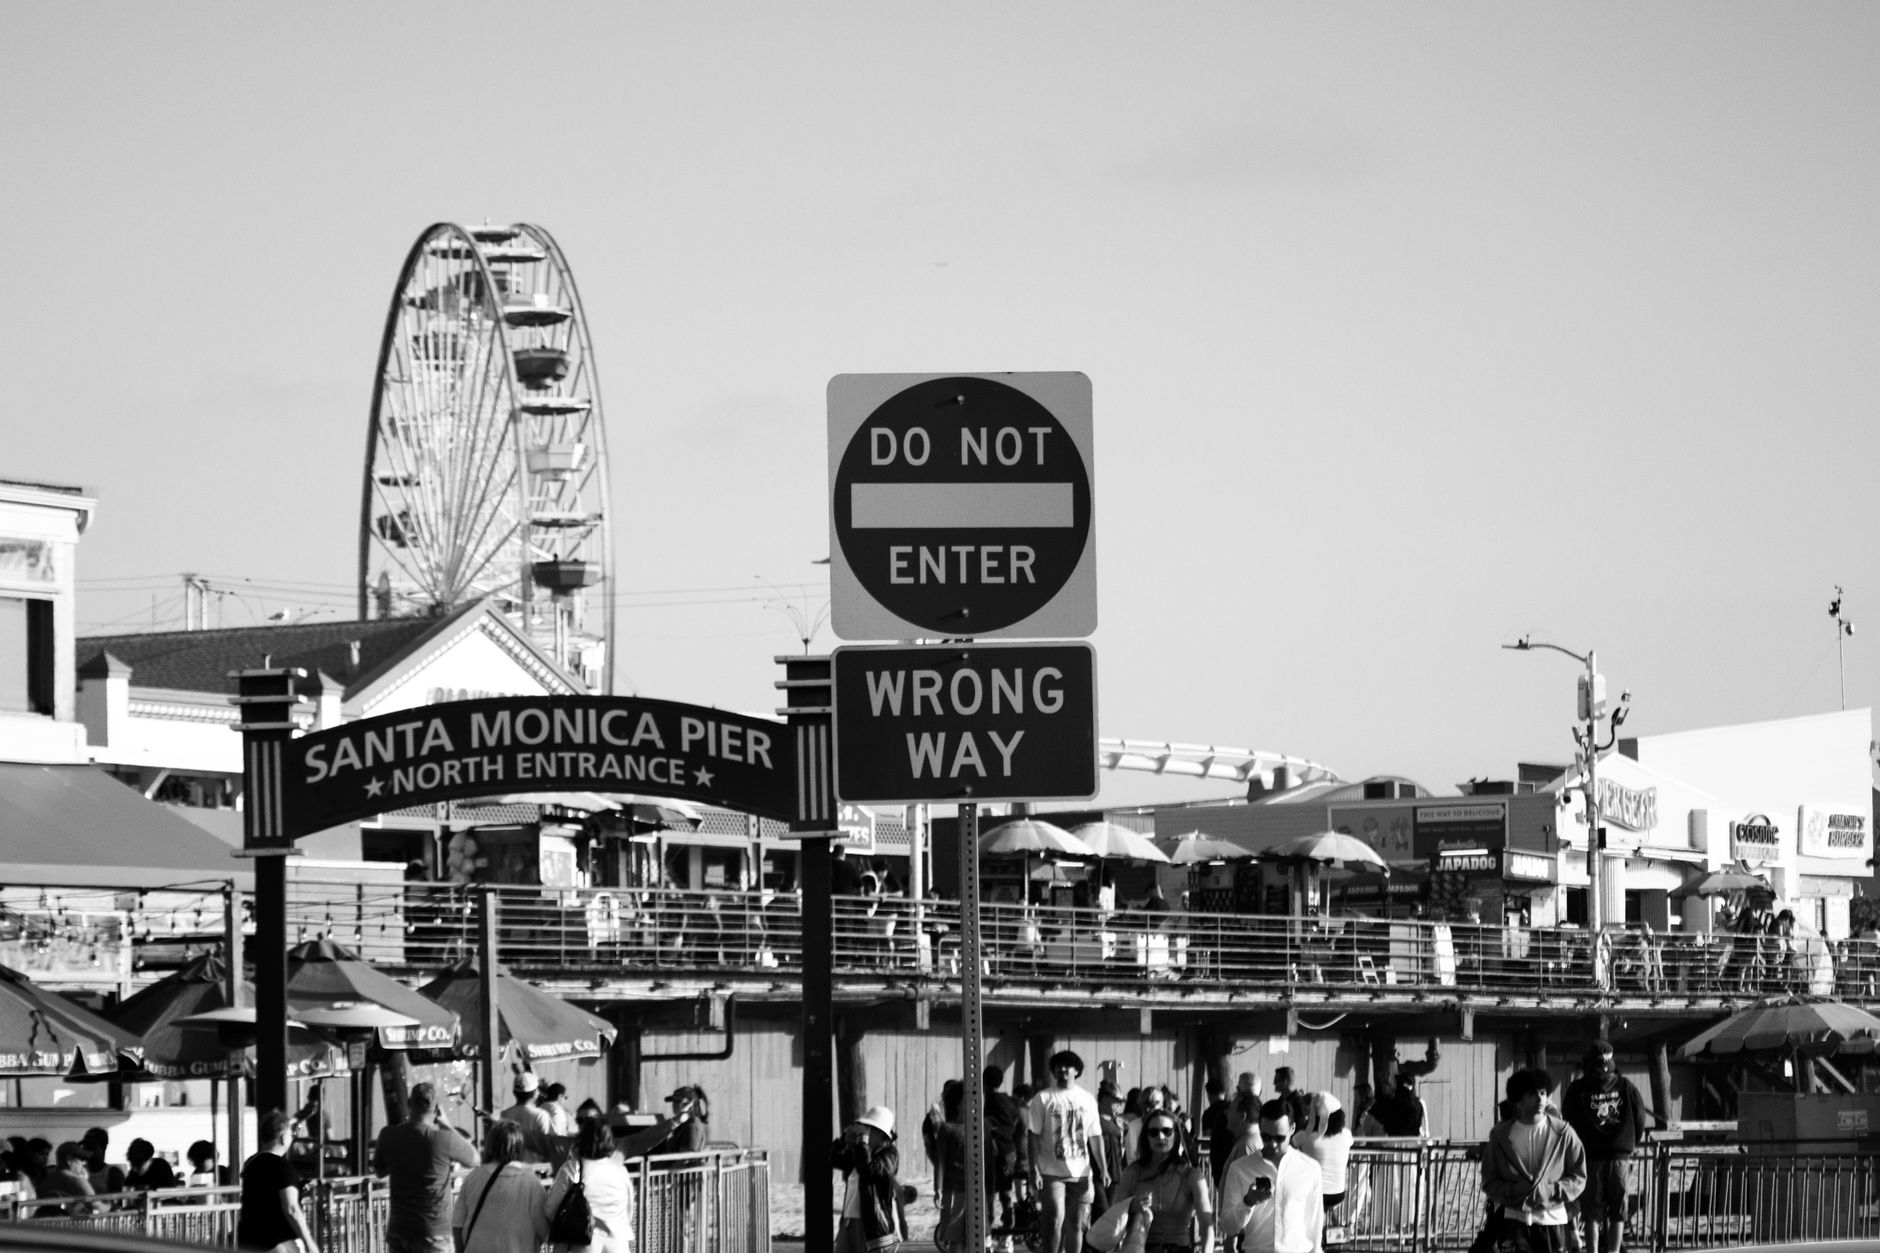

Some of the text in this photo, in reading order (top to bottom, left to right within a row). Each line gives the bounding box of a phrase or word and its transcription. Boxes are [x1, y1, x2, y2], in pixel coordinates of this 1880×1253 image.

[871, 427, 1051, 465] DO NOT
[890, 546, 1035, 584] ENTER
[866, 667, 1063, 716] WRONG
[306, 709, 772, 782] SANTA MONICA PIER
[907, 731, 1024, 778] WAY
[394, 753, 684, 793] NORTH ENTRANCE
[1436, 857, 1497, 872] JAPADOG
